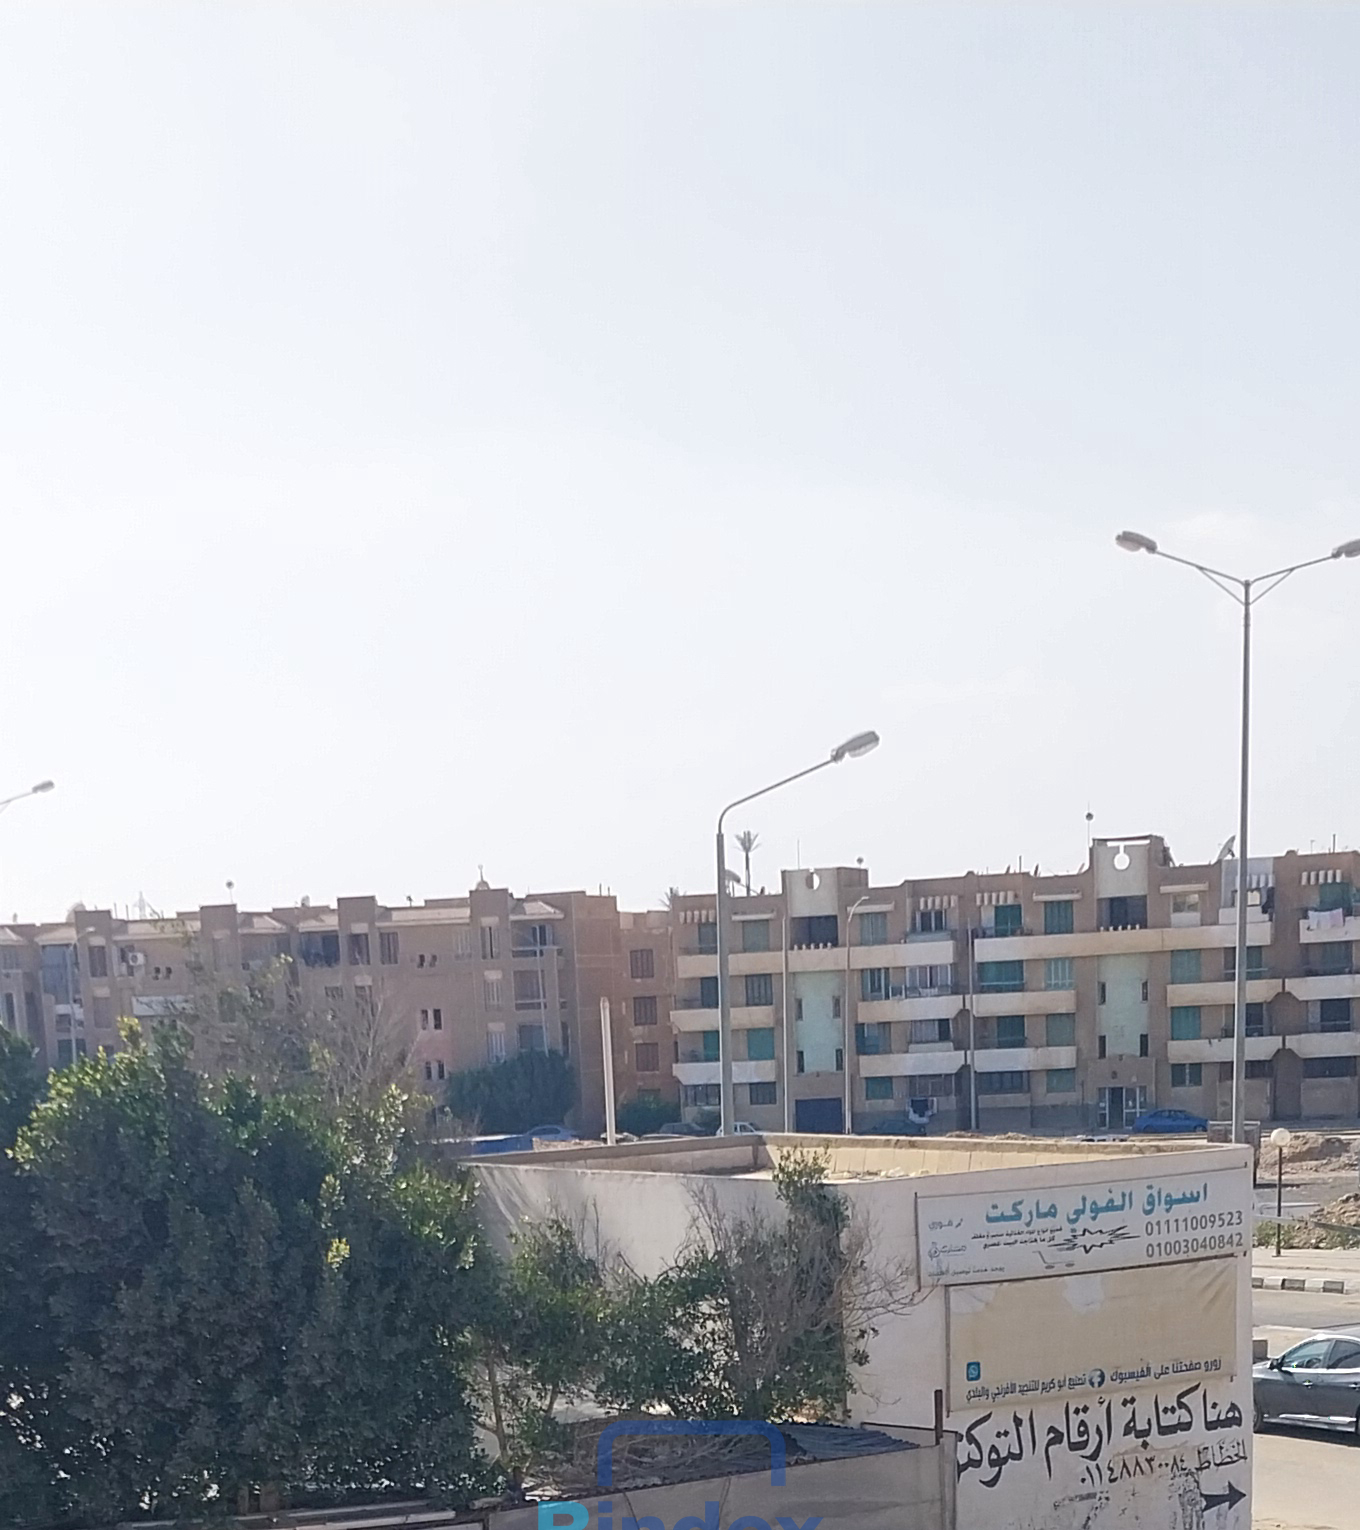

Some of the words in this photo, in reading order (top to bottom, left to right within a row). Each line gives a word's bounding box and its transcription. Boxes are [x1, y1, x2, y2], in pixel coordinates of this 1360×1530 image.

[985, 1199, 1058, 1227] ماركت
[1142, 1182, 1208, 1216] اسواق
[1145, 1210, 1243, 1236] 01111009523
[1146, 1232, 1243, 1258] 01003040842
[1110, 1363, 1151, 1384] الفيسبوك
[1172, 1360, 1202, 1374] صفحتنا
[1040, 1378, 1056, 1395] كريم
[1122, 1382, 1201, 1450] كتابة
[1203, 1388, 1243, 1432] هنا
[957, 1408, 1037, 1488] التوكت
[1044, 1395, 1113, 1481] أرقام
